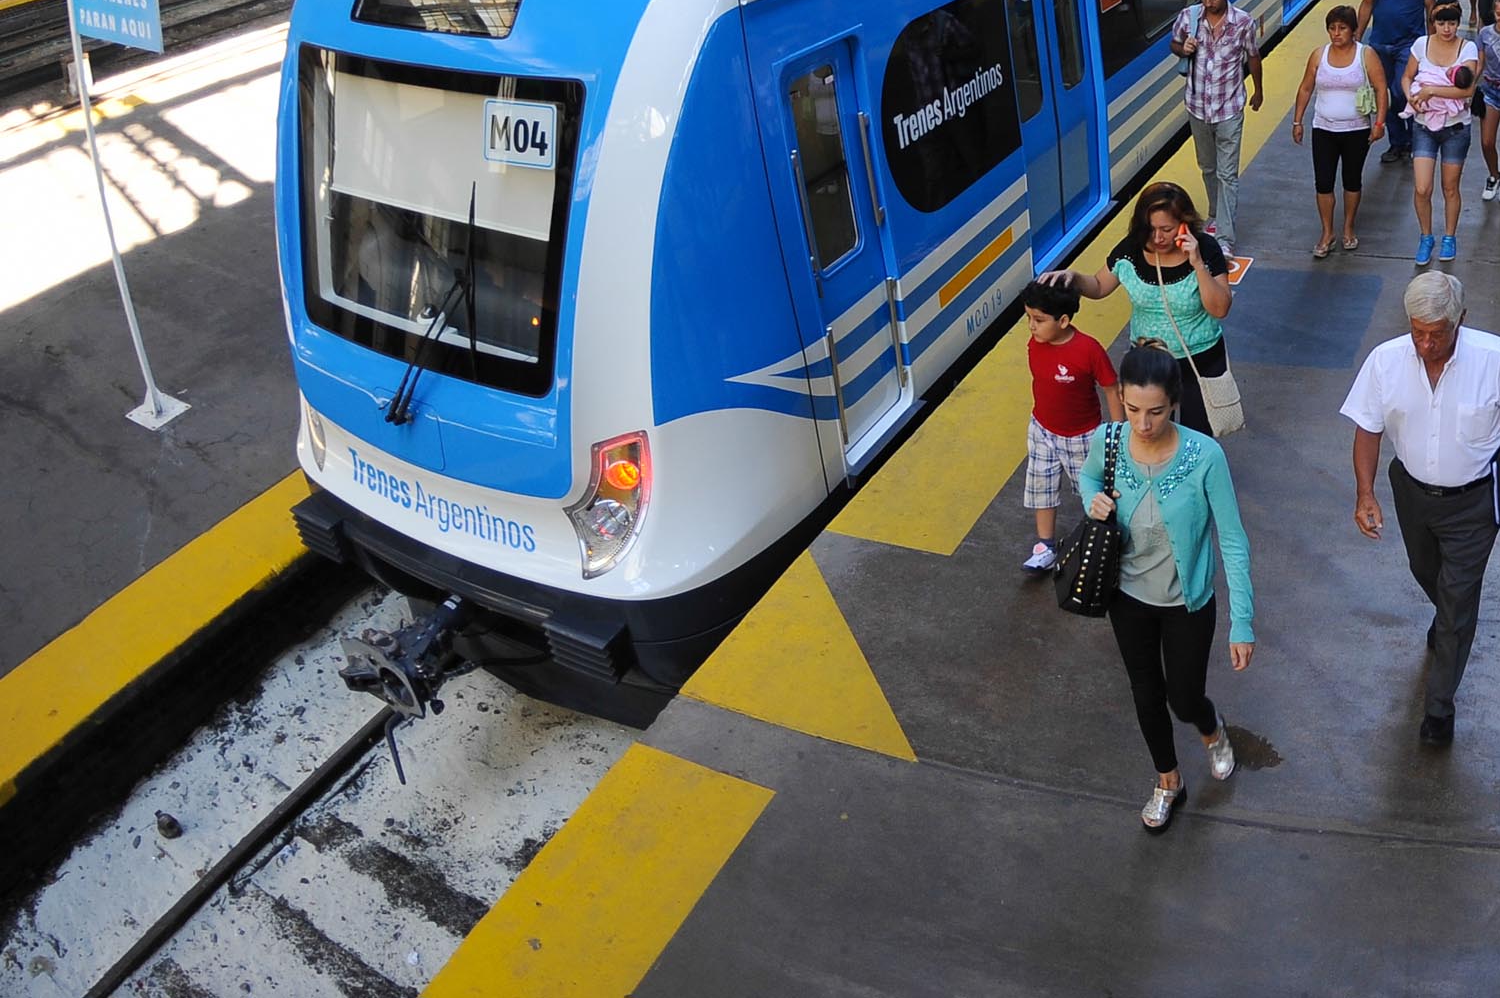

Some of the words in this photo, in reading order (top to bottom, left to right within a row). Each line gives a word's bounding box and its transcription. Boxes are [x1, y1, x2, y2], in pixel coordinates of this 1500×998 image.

[79, 8, 116, 32] PARAN
[121, 17, 152, 40] AQUI
[489, 114, 549, 157] M04
[893, 98, 943, 150] Trenes
[943, 63, 1003, 119] Argentinos
[348, 447, 411, 509] Trenes
[415, 481, 536, 553] Argentinos
